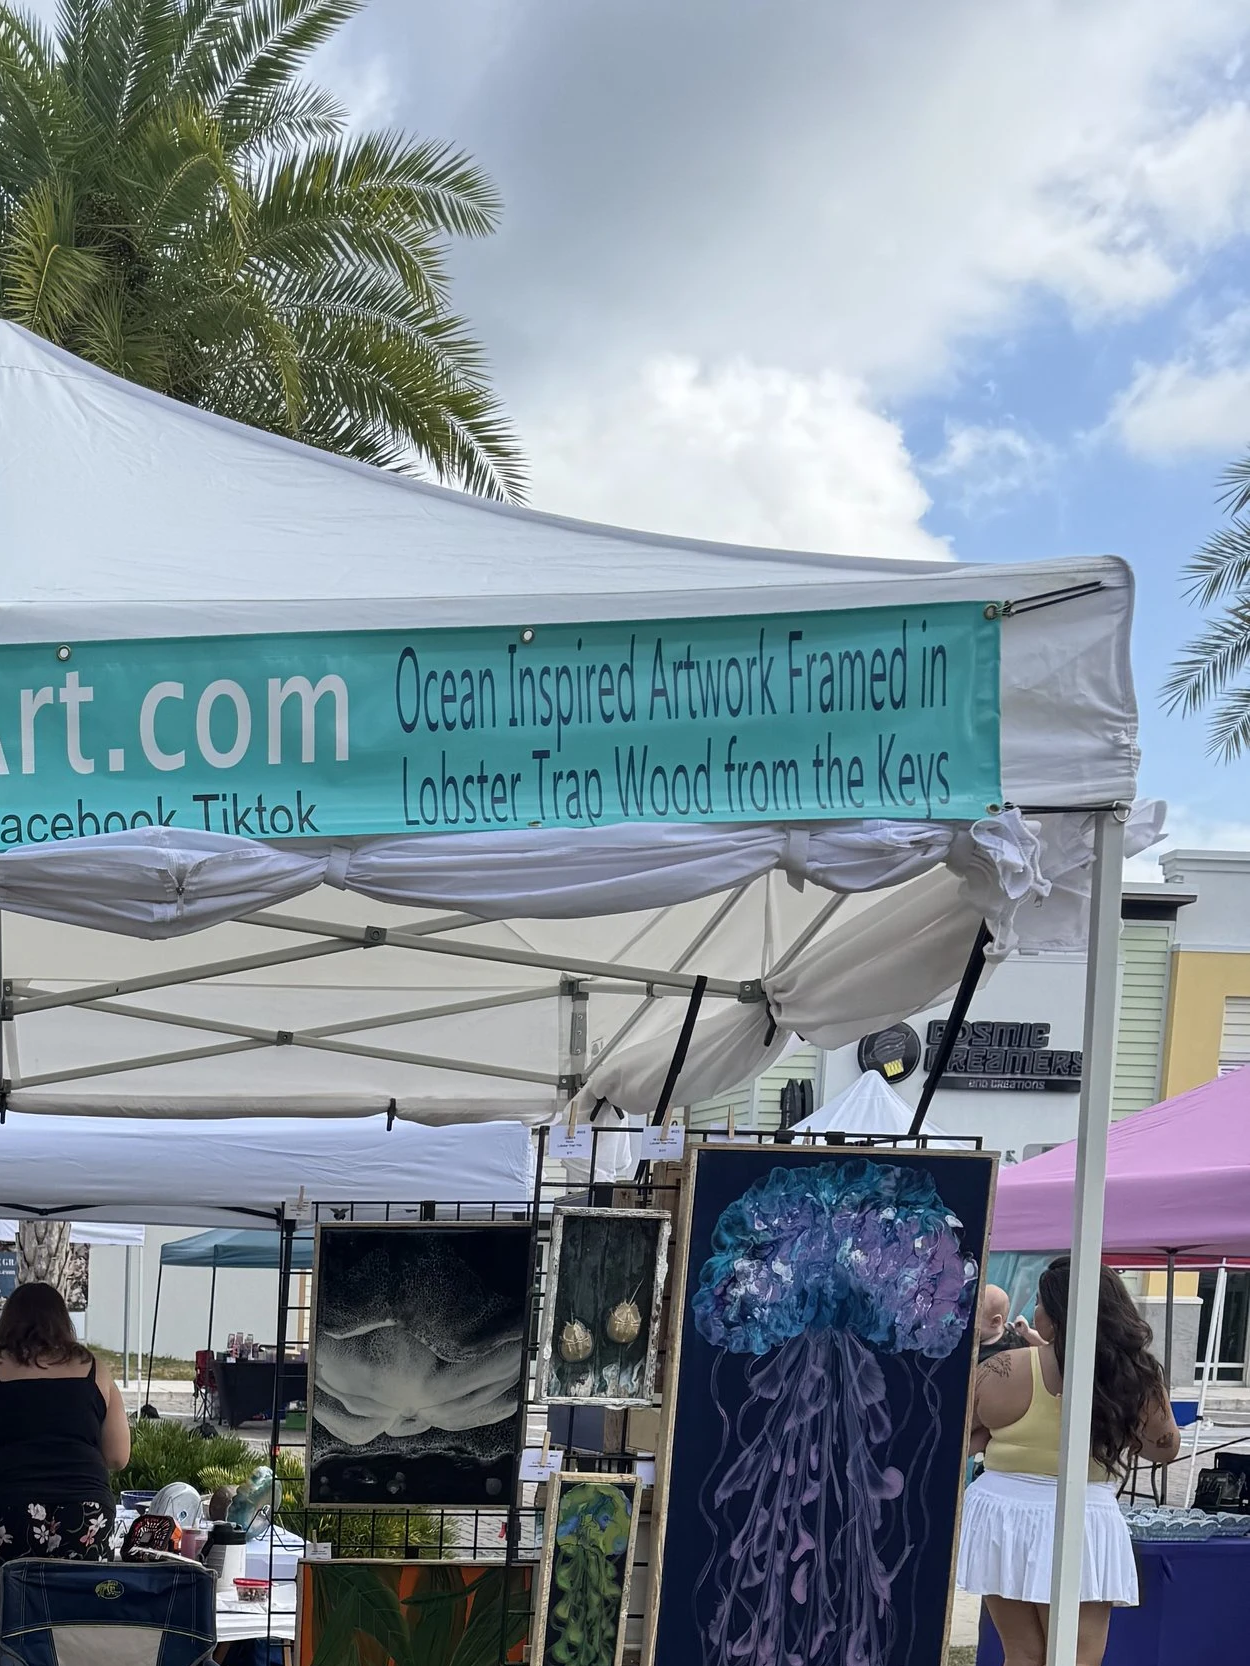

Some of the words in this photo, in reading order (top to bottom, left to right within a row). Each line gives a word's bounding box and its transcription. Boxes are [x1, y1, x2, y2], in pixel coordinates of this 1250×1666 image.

[395, 646, 495, 734] Ocean
[507, 637, 636, 752] Inspired
[649, 627, 778, 721] Artwork
[788, 618, 907, 714] Framed
[921, 619, 948, 709] in
[192, 790, 321, 836] Tiktok
[402, 751, 522, 826] Lobster
[531, 749, 603, 825] Trap
[614, 739, 712, 817] Wood
[724, 735, 800, 813] from
[812, 732, 864, 810] the
[877, 733, 951, 820] Keys
[2, 1257, 16, 1266] GR
